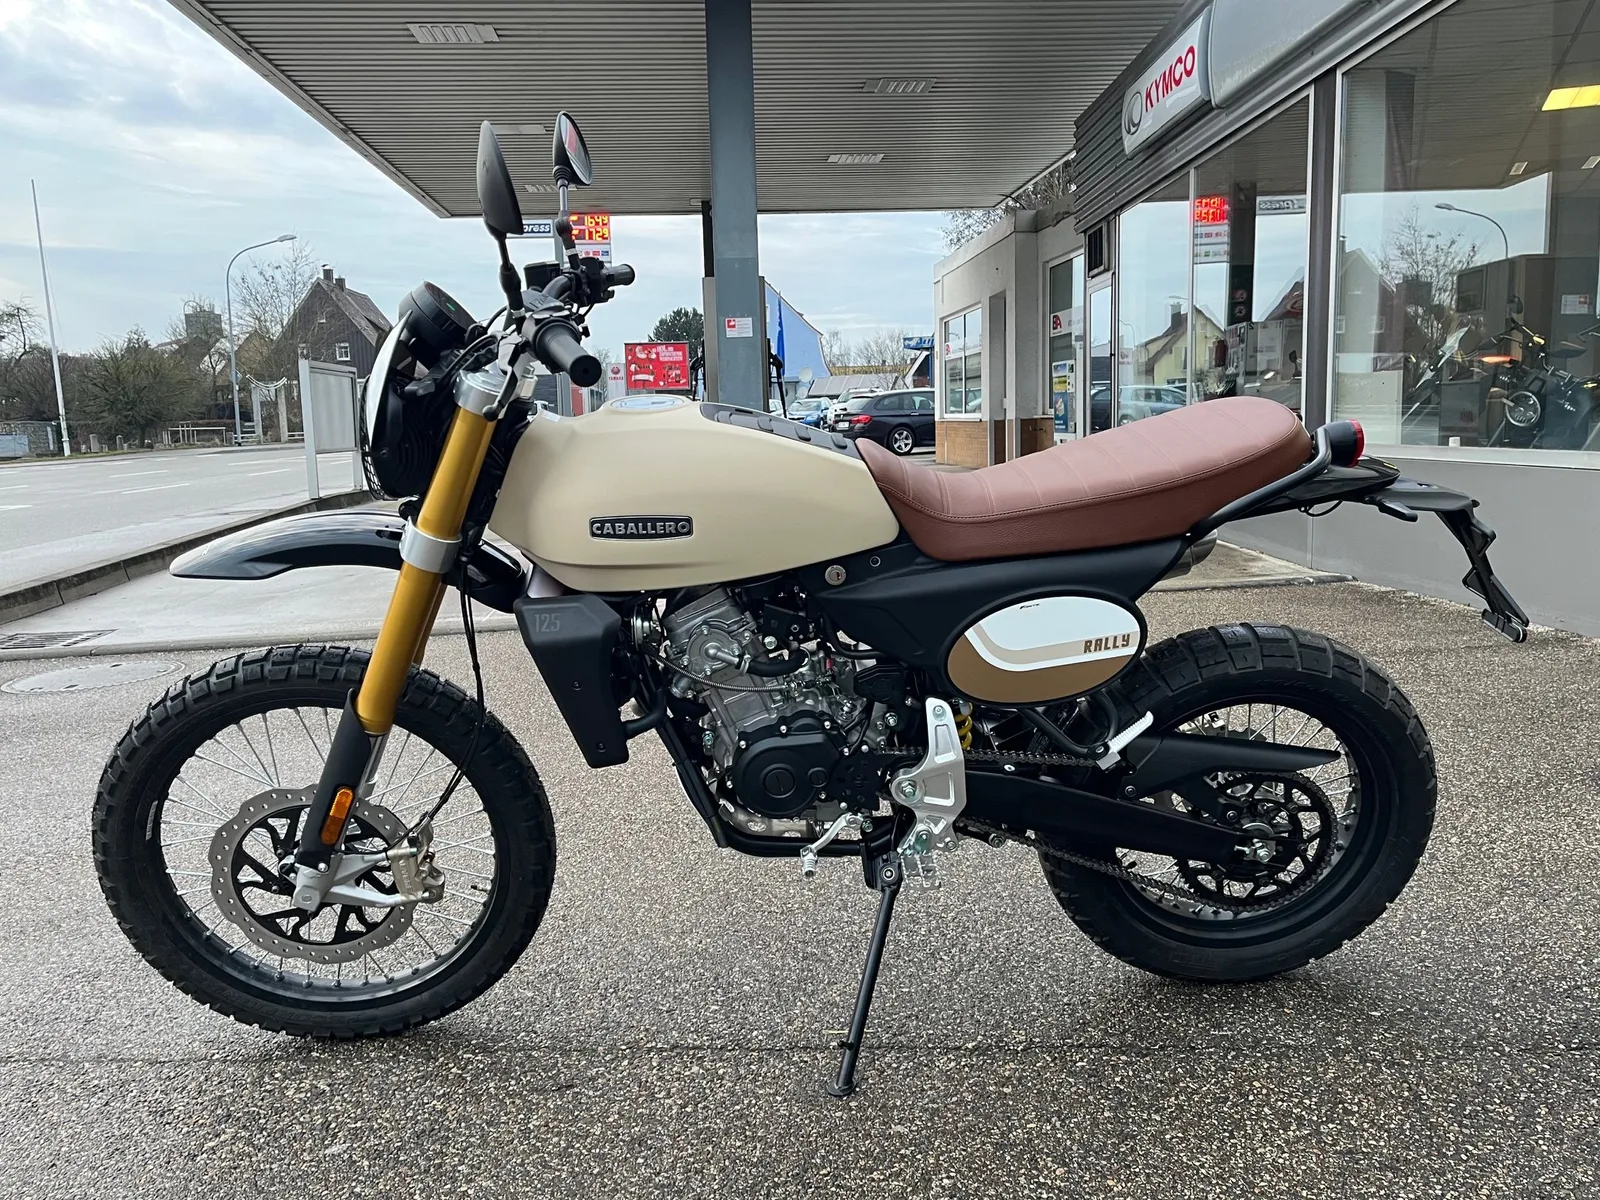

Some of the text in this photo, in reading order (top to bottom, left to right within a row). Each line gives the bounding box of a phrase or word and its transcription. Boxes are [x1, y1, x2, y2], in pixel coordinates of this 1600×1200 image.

[1145, 45, 1195, 112] KYMCO
[584, 215, 609, 227] 1649
[585, 228, 609, 241] 1729
[592, 521, 690, 534] CABALLERO
[534, 613, 562, 633] 125
[1083, 633, 1131, 654] RALLY
